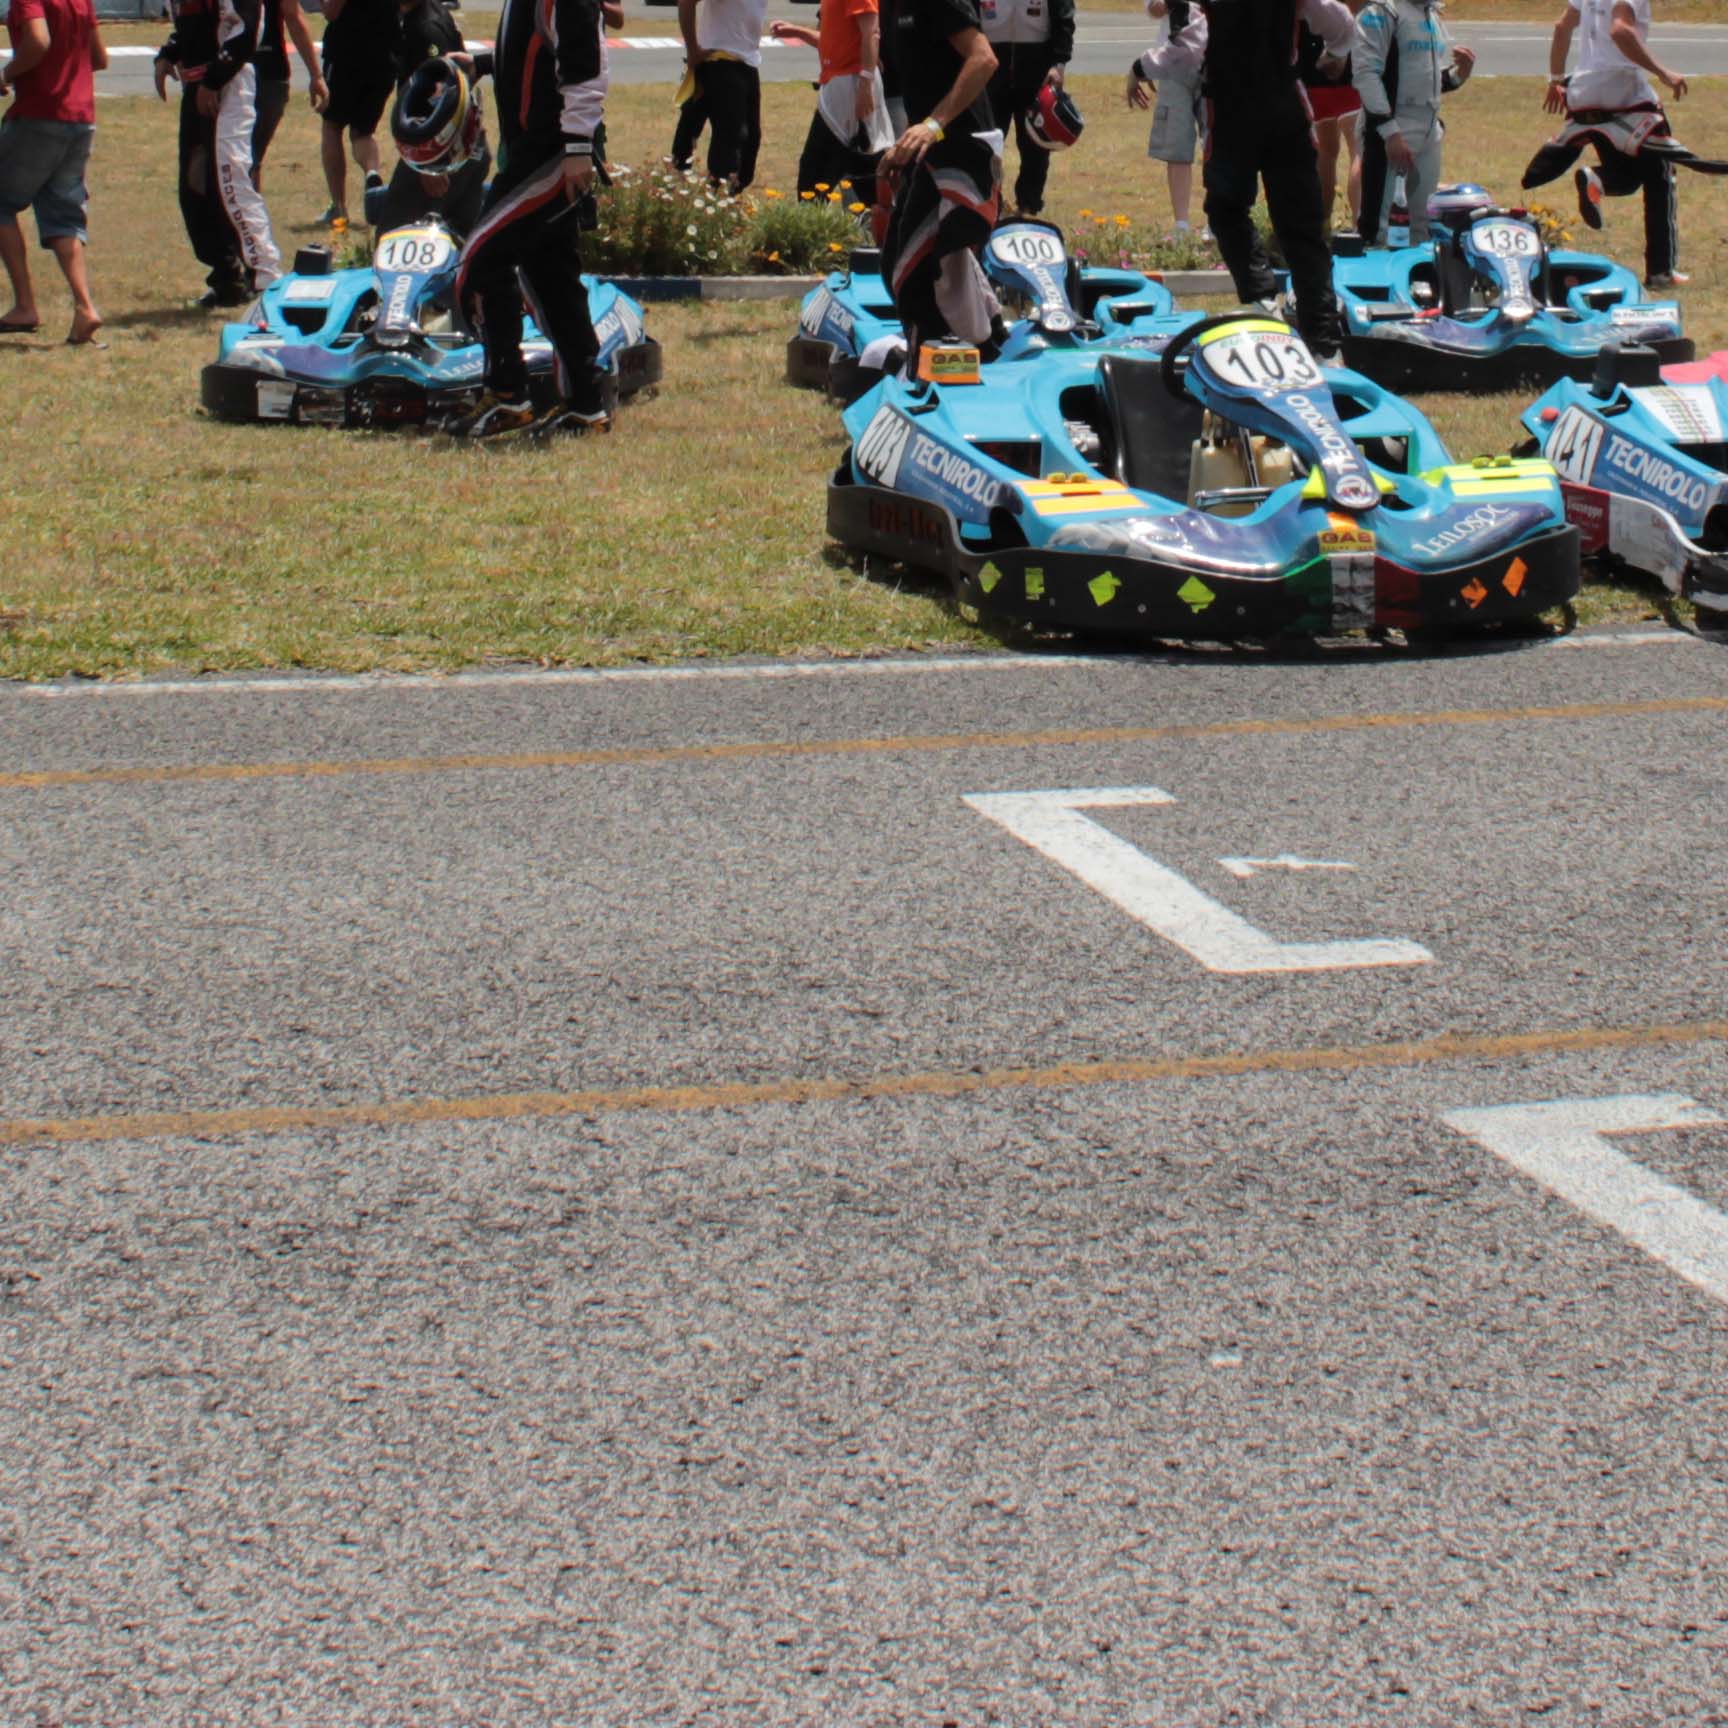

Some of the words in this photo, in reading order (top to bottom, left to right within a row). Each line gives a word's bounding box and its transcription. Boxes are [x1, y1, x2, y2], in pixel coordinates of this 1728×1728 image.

[385, 241, 435, 265] 108
[1007, 237, 1054, 262] 100
[1484, 230, 1529, 252] 136
[931, 352, 977, 364] GAS
[1227, 342, 1316, 384] 103
[1287, 394, 1359, 474] TECNIROLO
[910, 433, 1001, 508] TECNIROLO
[1605, 434, 1707, 512] TECNIROLO
[1322, 530, 1373, 544] GAS
